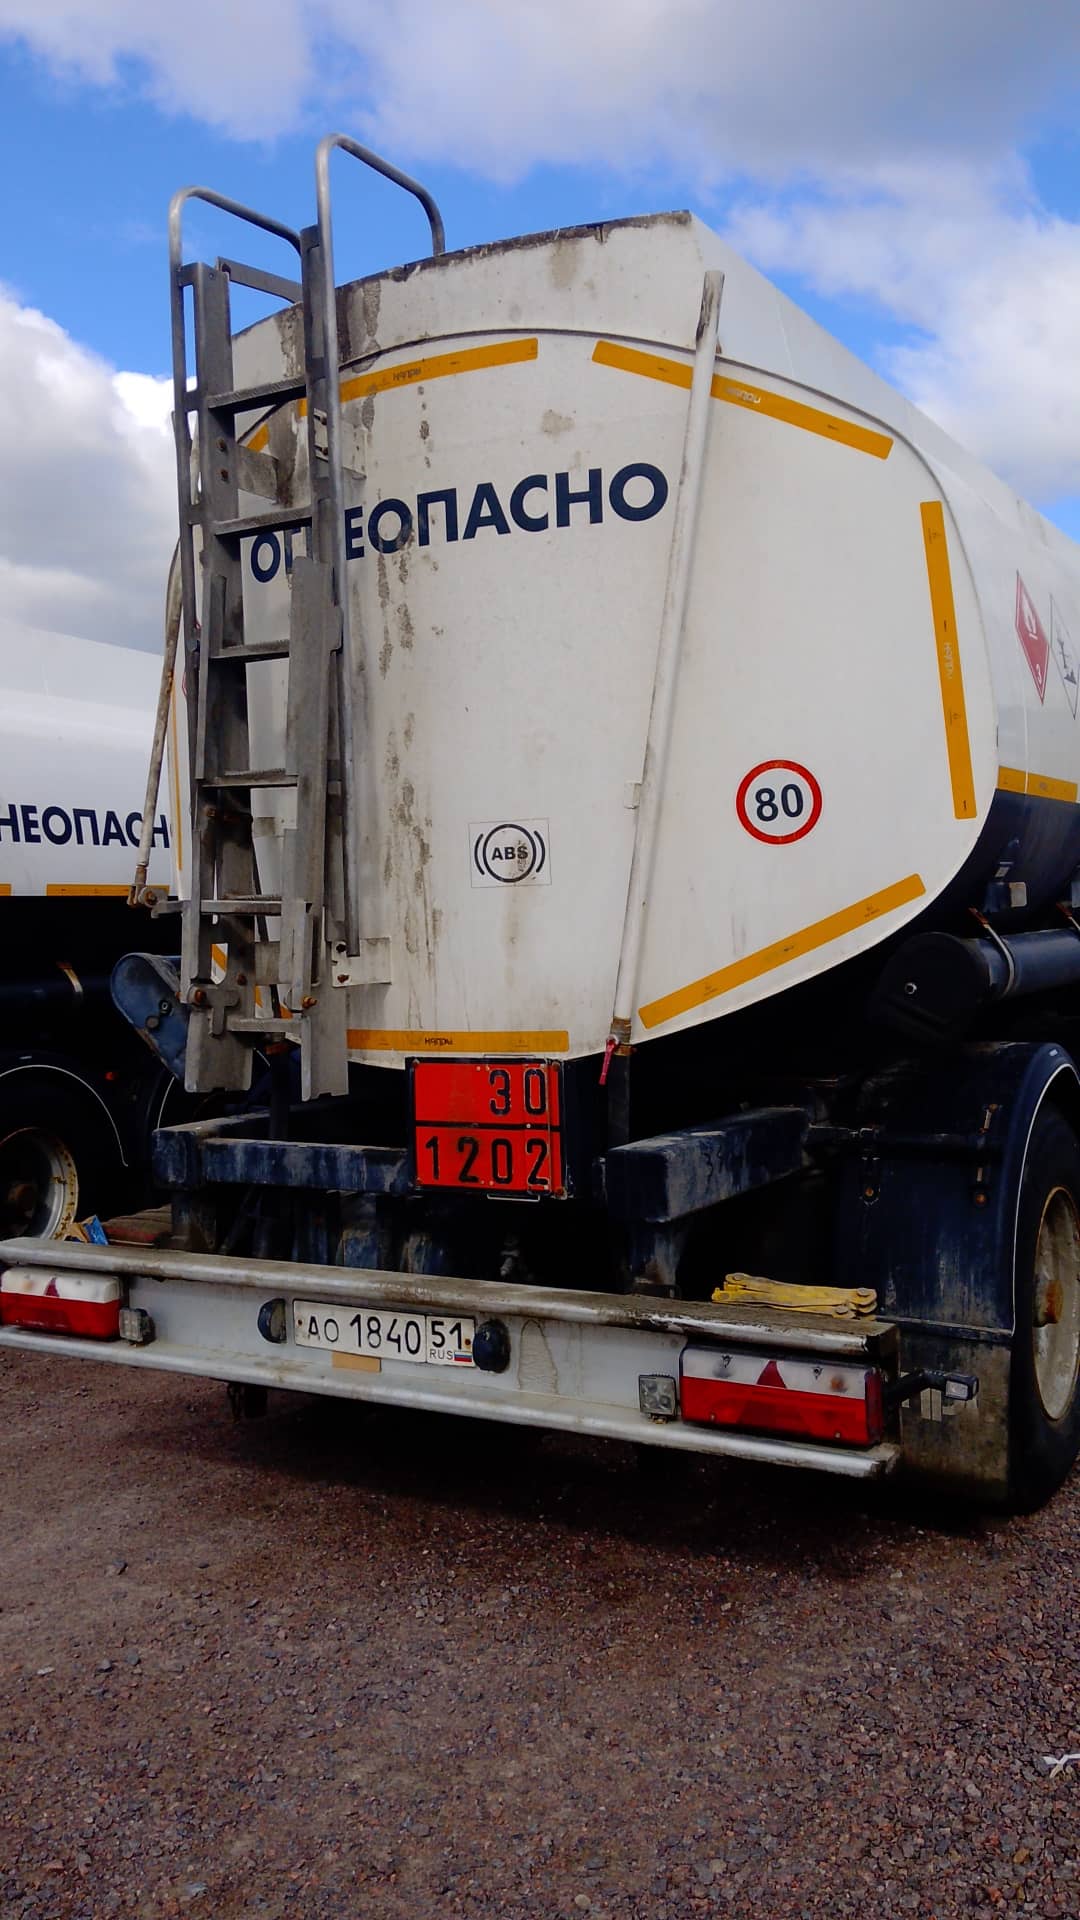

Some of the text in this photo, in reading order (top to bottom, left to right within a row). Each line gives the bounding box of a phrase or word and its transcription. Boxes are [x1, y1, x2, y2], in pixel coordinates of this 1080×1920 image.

[755, 783, 803, 822] 80
[0, 804, 172, 848] НЕОПАСН
[491, 846, 528, 861] ABS
[489, 1068, 548, 1116] 30
[425, 1135, 549, 1186] 1202
[350, 1314, 421, 1355] 1840
[431, 1320, 462, 1350] 51
[429, 1349, 453, 1360] RUS
